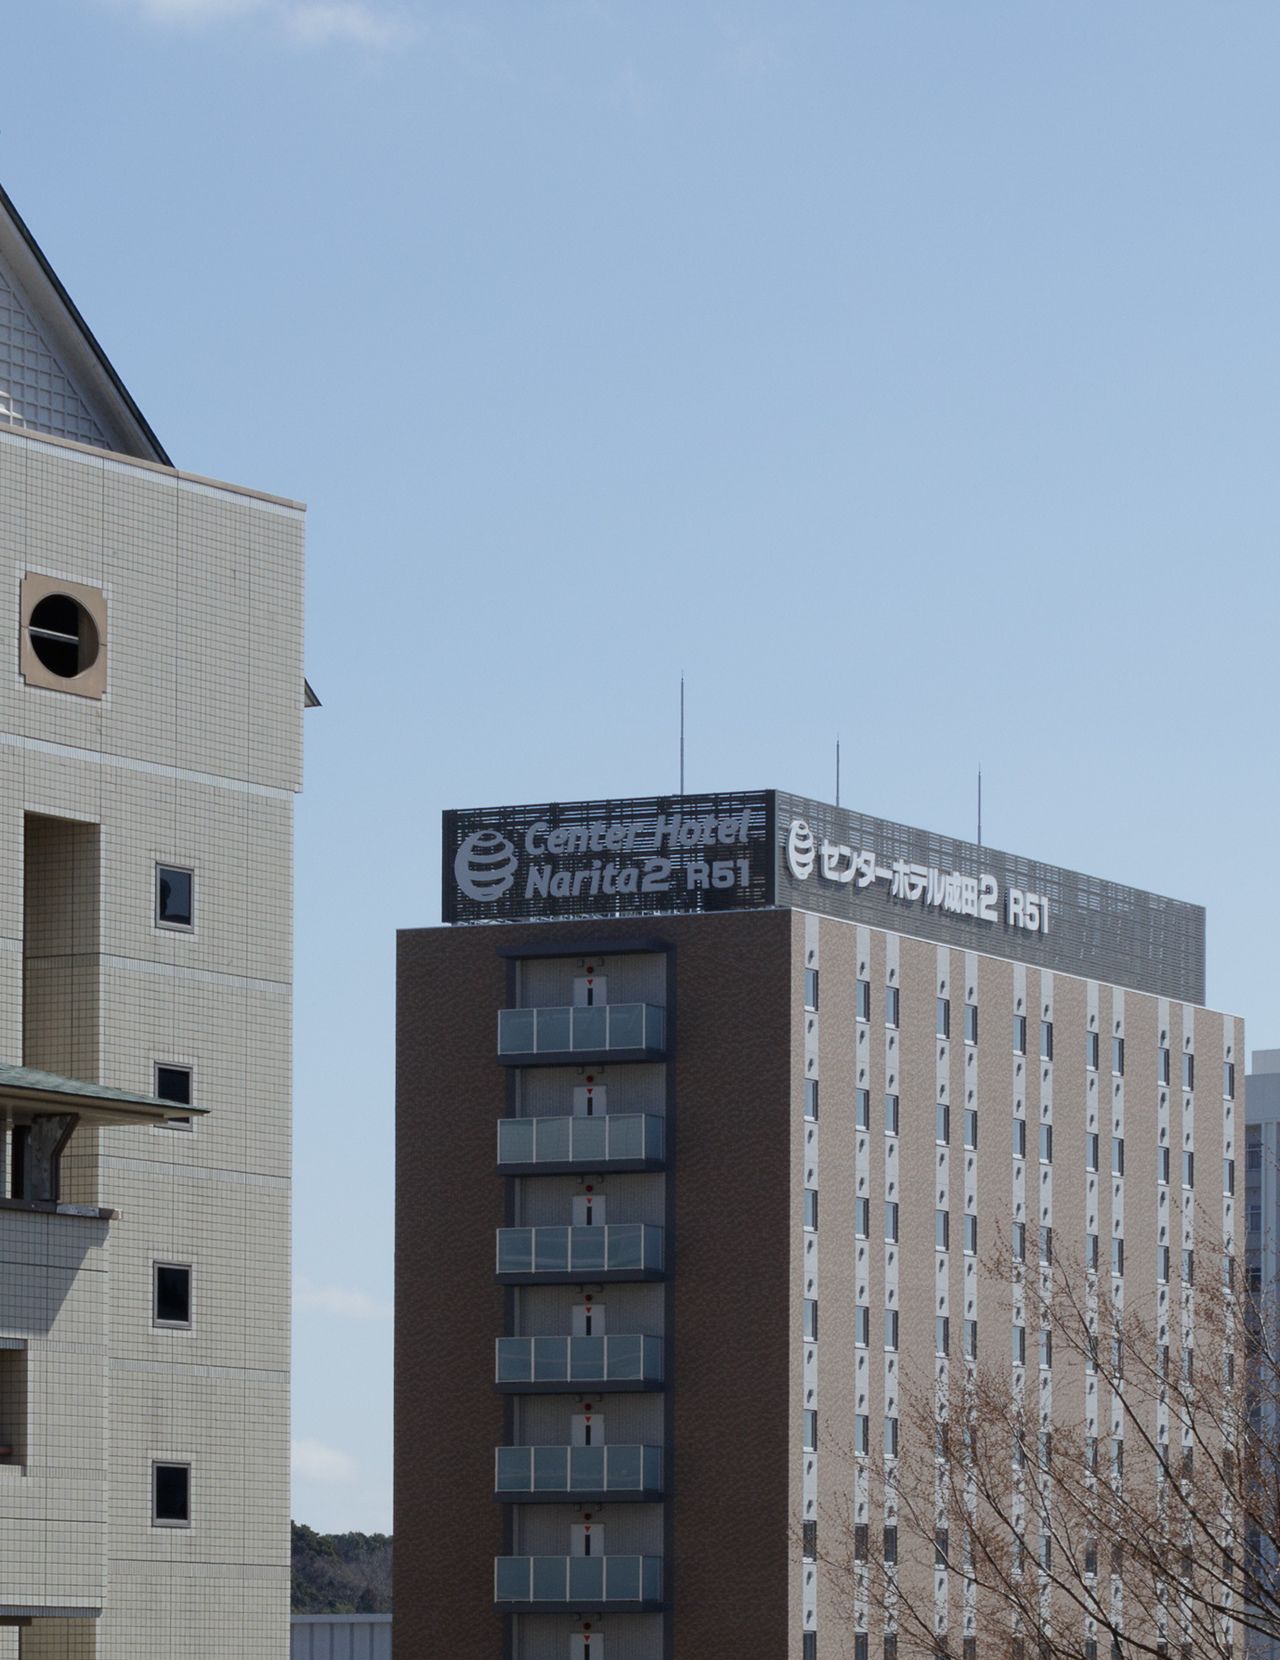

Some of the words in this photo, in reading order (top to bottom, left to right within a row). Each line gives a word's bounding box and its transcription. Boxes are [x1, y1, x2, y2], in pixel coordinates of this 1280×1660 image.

[524, 819, 645, 856] Center
[653, 808, 752, 847] Hotel
[524, 857, 671, 900] Narita2
[686, 858, 750, 891] R51
[819, 838, 999, 923] センターホテル成田2
[1007, 886, 1049, 934] R51
